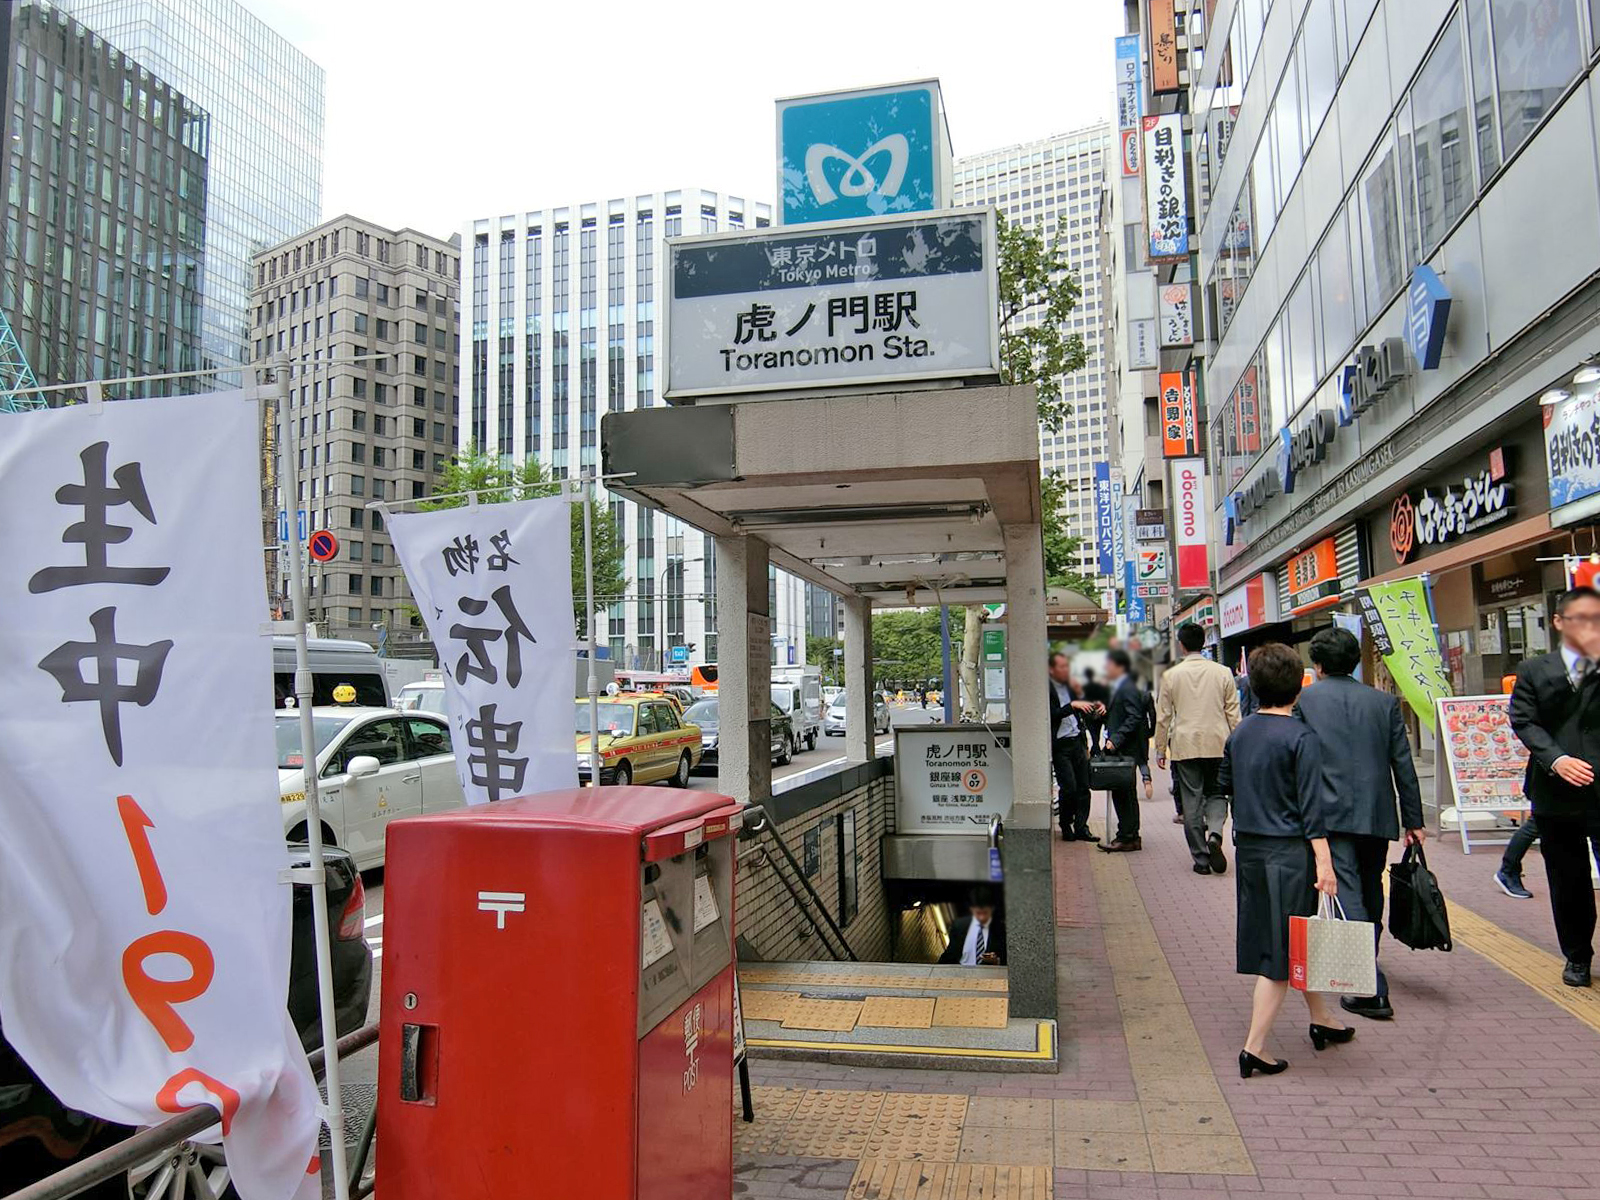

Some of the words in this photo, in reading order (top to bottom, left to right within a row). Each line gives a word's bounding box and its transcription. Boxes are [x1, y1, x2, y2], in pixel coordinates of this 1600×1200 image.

[1154, 127, 1181, 240] 目利きの銀次
[772, 238, 876, 266] 東京メトロ
[779, 266, 823, 284] Tokyo
[826, 263, 871, 279] Metro
[733, 290, 920, 345] 虎ノ門駅
[1167, 319, 1182, 343] うどん
[719, 343, 874, 373] Toranomon
[883, 335, 936, 359] Sta.
[1164, 387, 1182, 440] 吉野家
[1183, 386, 1193, 440] YOSHINOYA
[1181, 469, 1196, 537] docomo
[1414, 470, 1506, 545] はなまるうどん
[925, 759, 971, 767] Toranomon
[974, 759, 989, 767] Sta.
[926, 744, 988, 759] 虎ノ門駅
[929, 771, 962, 782] 銀座線
[969, 780, 980, 788] 07
[684, 1003, 700, 1042] 郵便
[682, 1057, 699, 1096] POST
